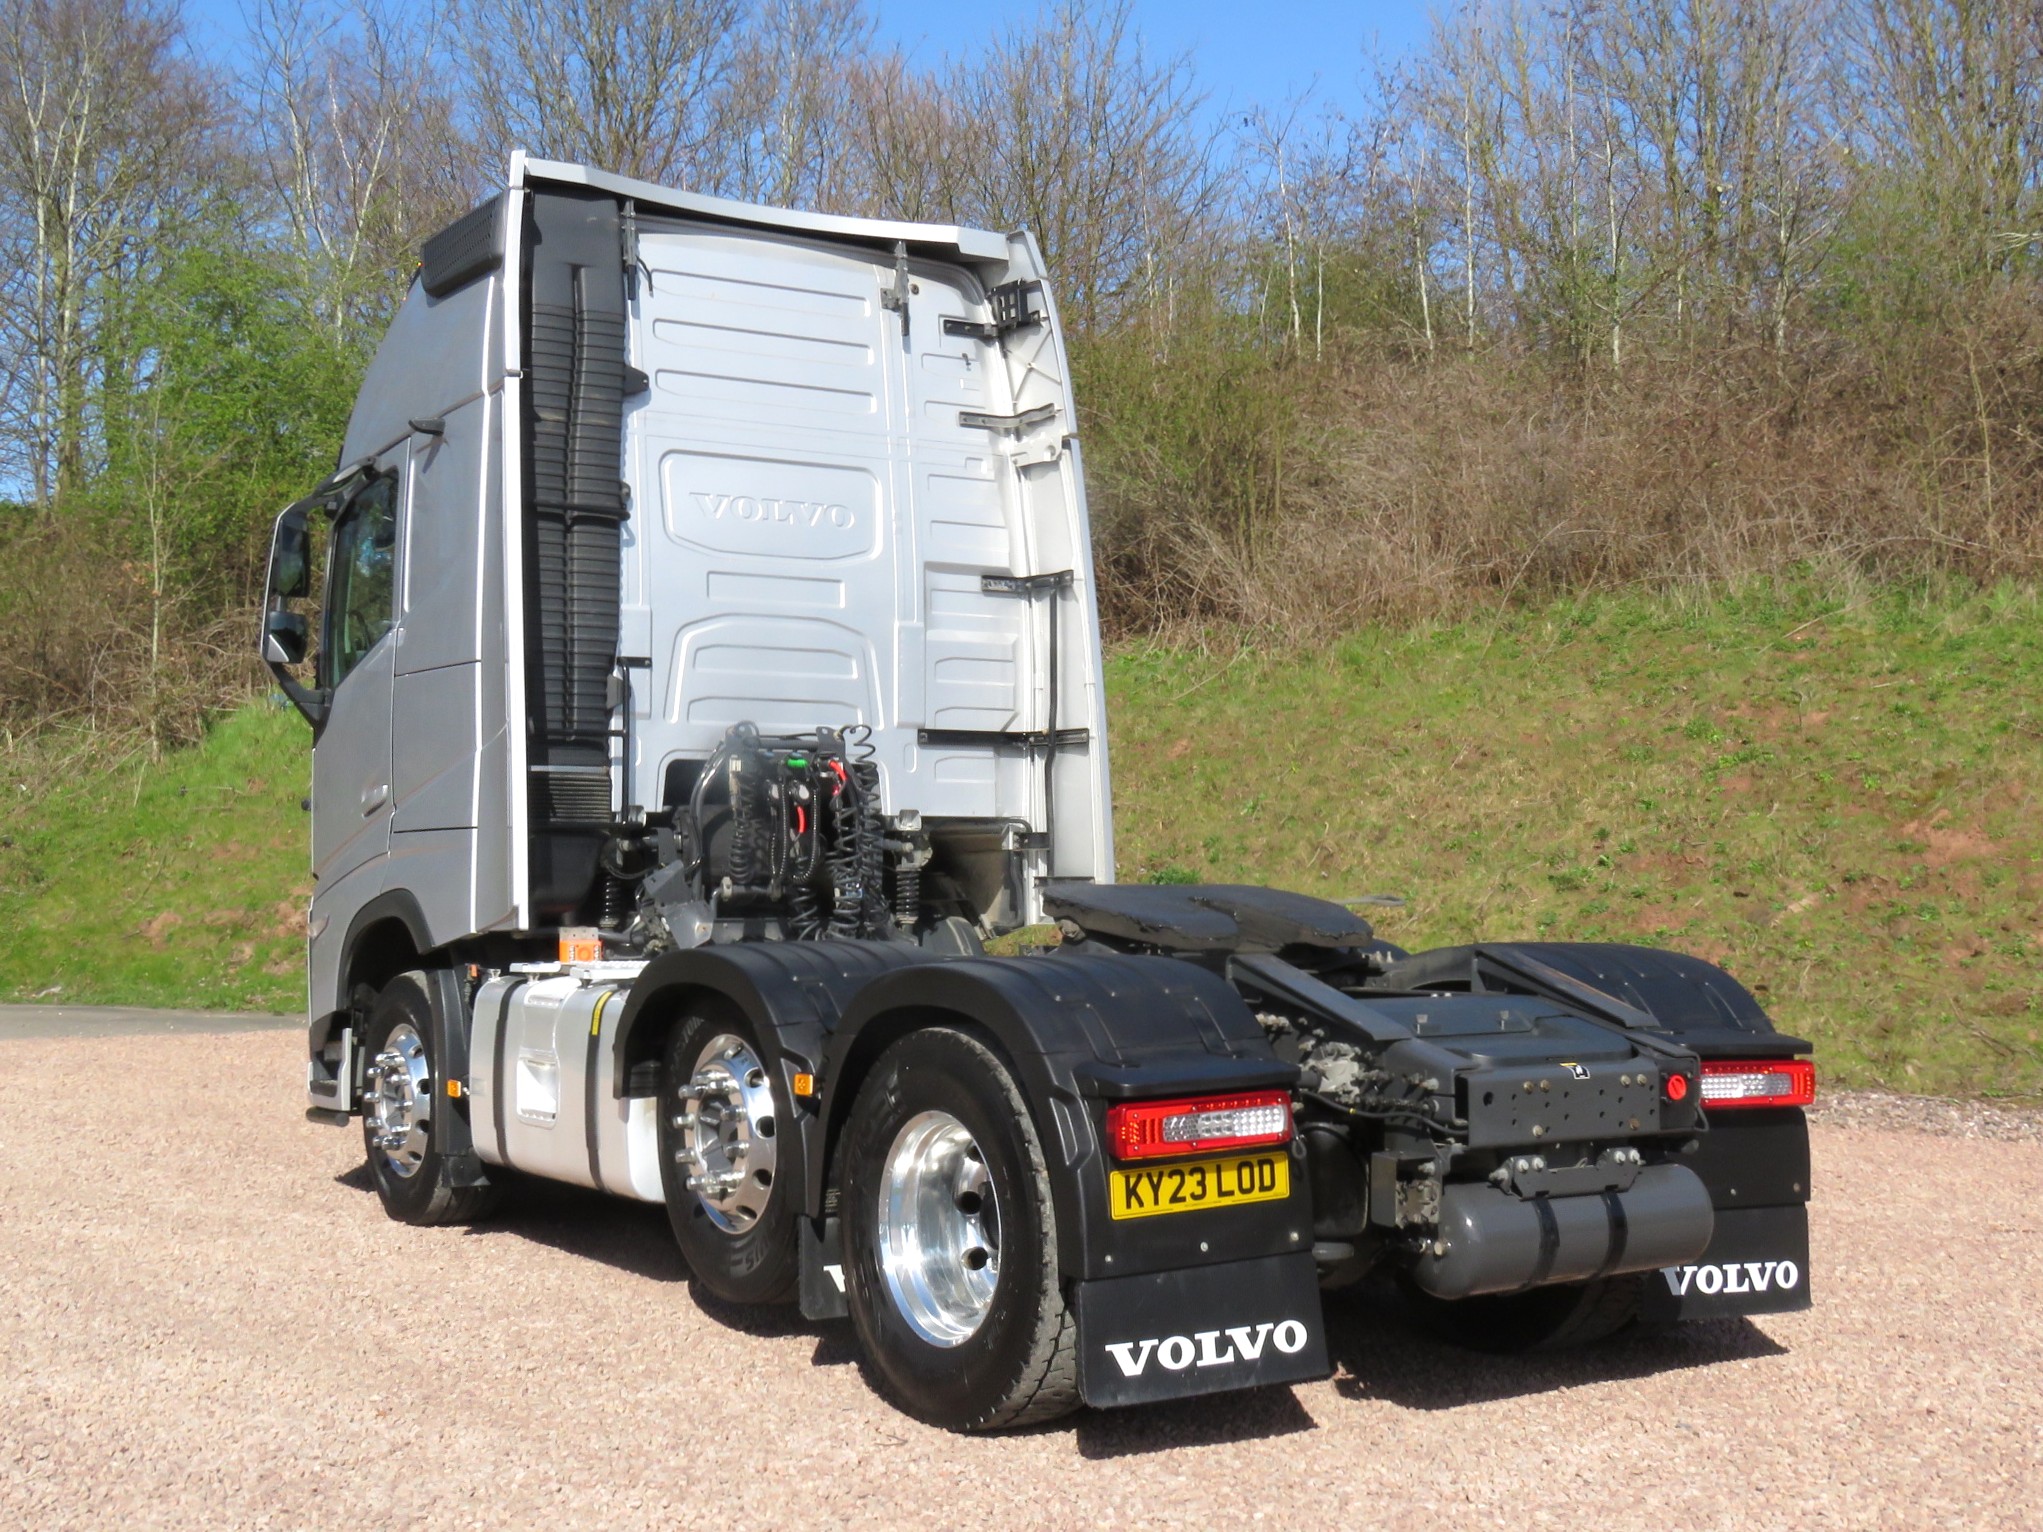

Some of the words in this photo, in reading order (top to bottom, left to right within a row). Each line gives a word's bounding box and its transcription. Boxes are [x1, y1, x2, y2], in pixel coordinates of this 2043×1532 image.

[689, 491, 855, 529] VOLVO
[1124, 1166, 1208, 1209] KY23
[1216, 1158, 1276, 1198] LOD
[1660, 1260, 1799, 1296] VOLVO
[1104, 1319, 1308, 1378] VOLVO
